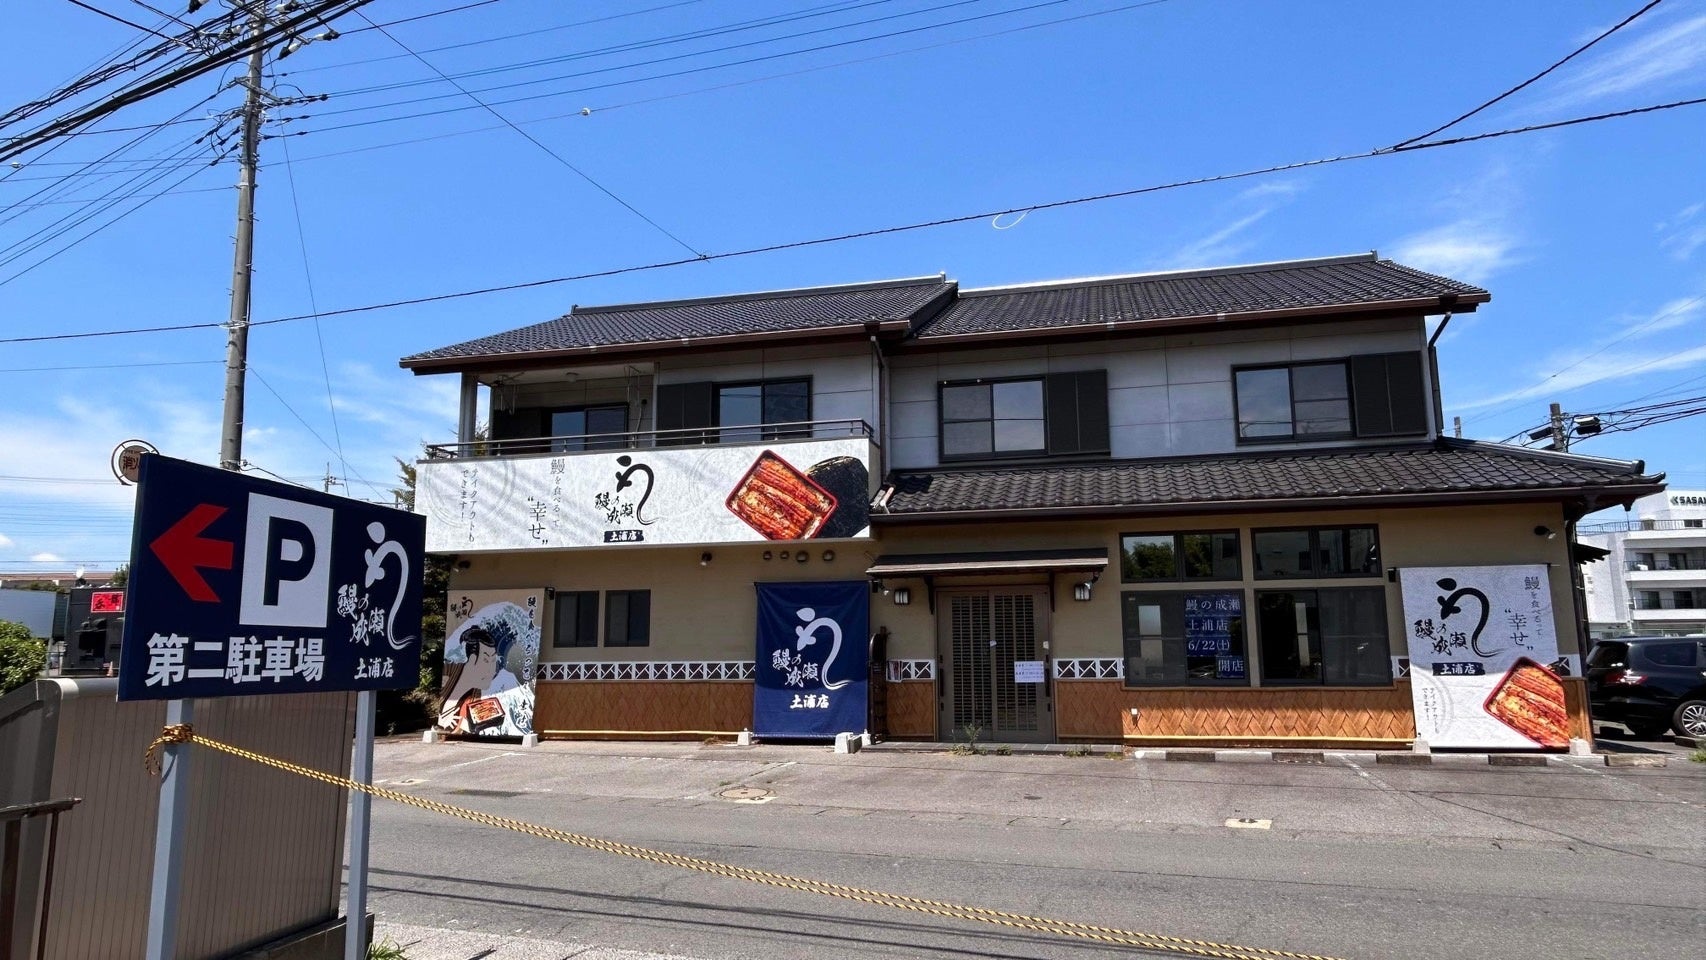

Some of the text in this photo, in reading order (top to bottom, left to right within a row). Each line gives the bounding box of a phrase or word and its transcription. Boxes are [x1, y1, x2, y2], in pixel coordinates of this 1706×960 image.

[609, 530, 638, 542] 土浦店
[263, 515, 316, 607] P
[336, 583, 386, 646] 鰻の成瀬
[1185, 599, 1241, 611] 鰻の成瀬
[1189, 619, 1228, 631] 土浦店
[1414, 618, 1469, 656] 鰻の成瀬
[145, 632, 326, 687] 第二駐車場
[354, 656, 395, 680] 土浦店
[772, 648, 819, 688] 鰻の成瀬
[1218, 660, 1244, 672] 開店
[1440, 663, 1476, 675] 土浦店
[789, 694, 830, 709] 土浦店
